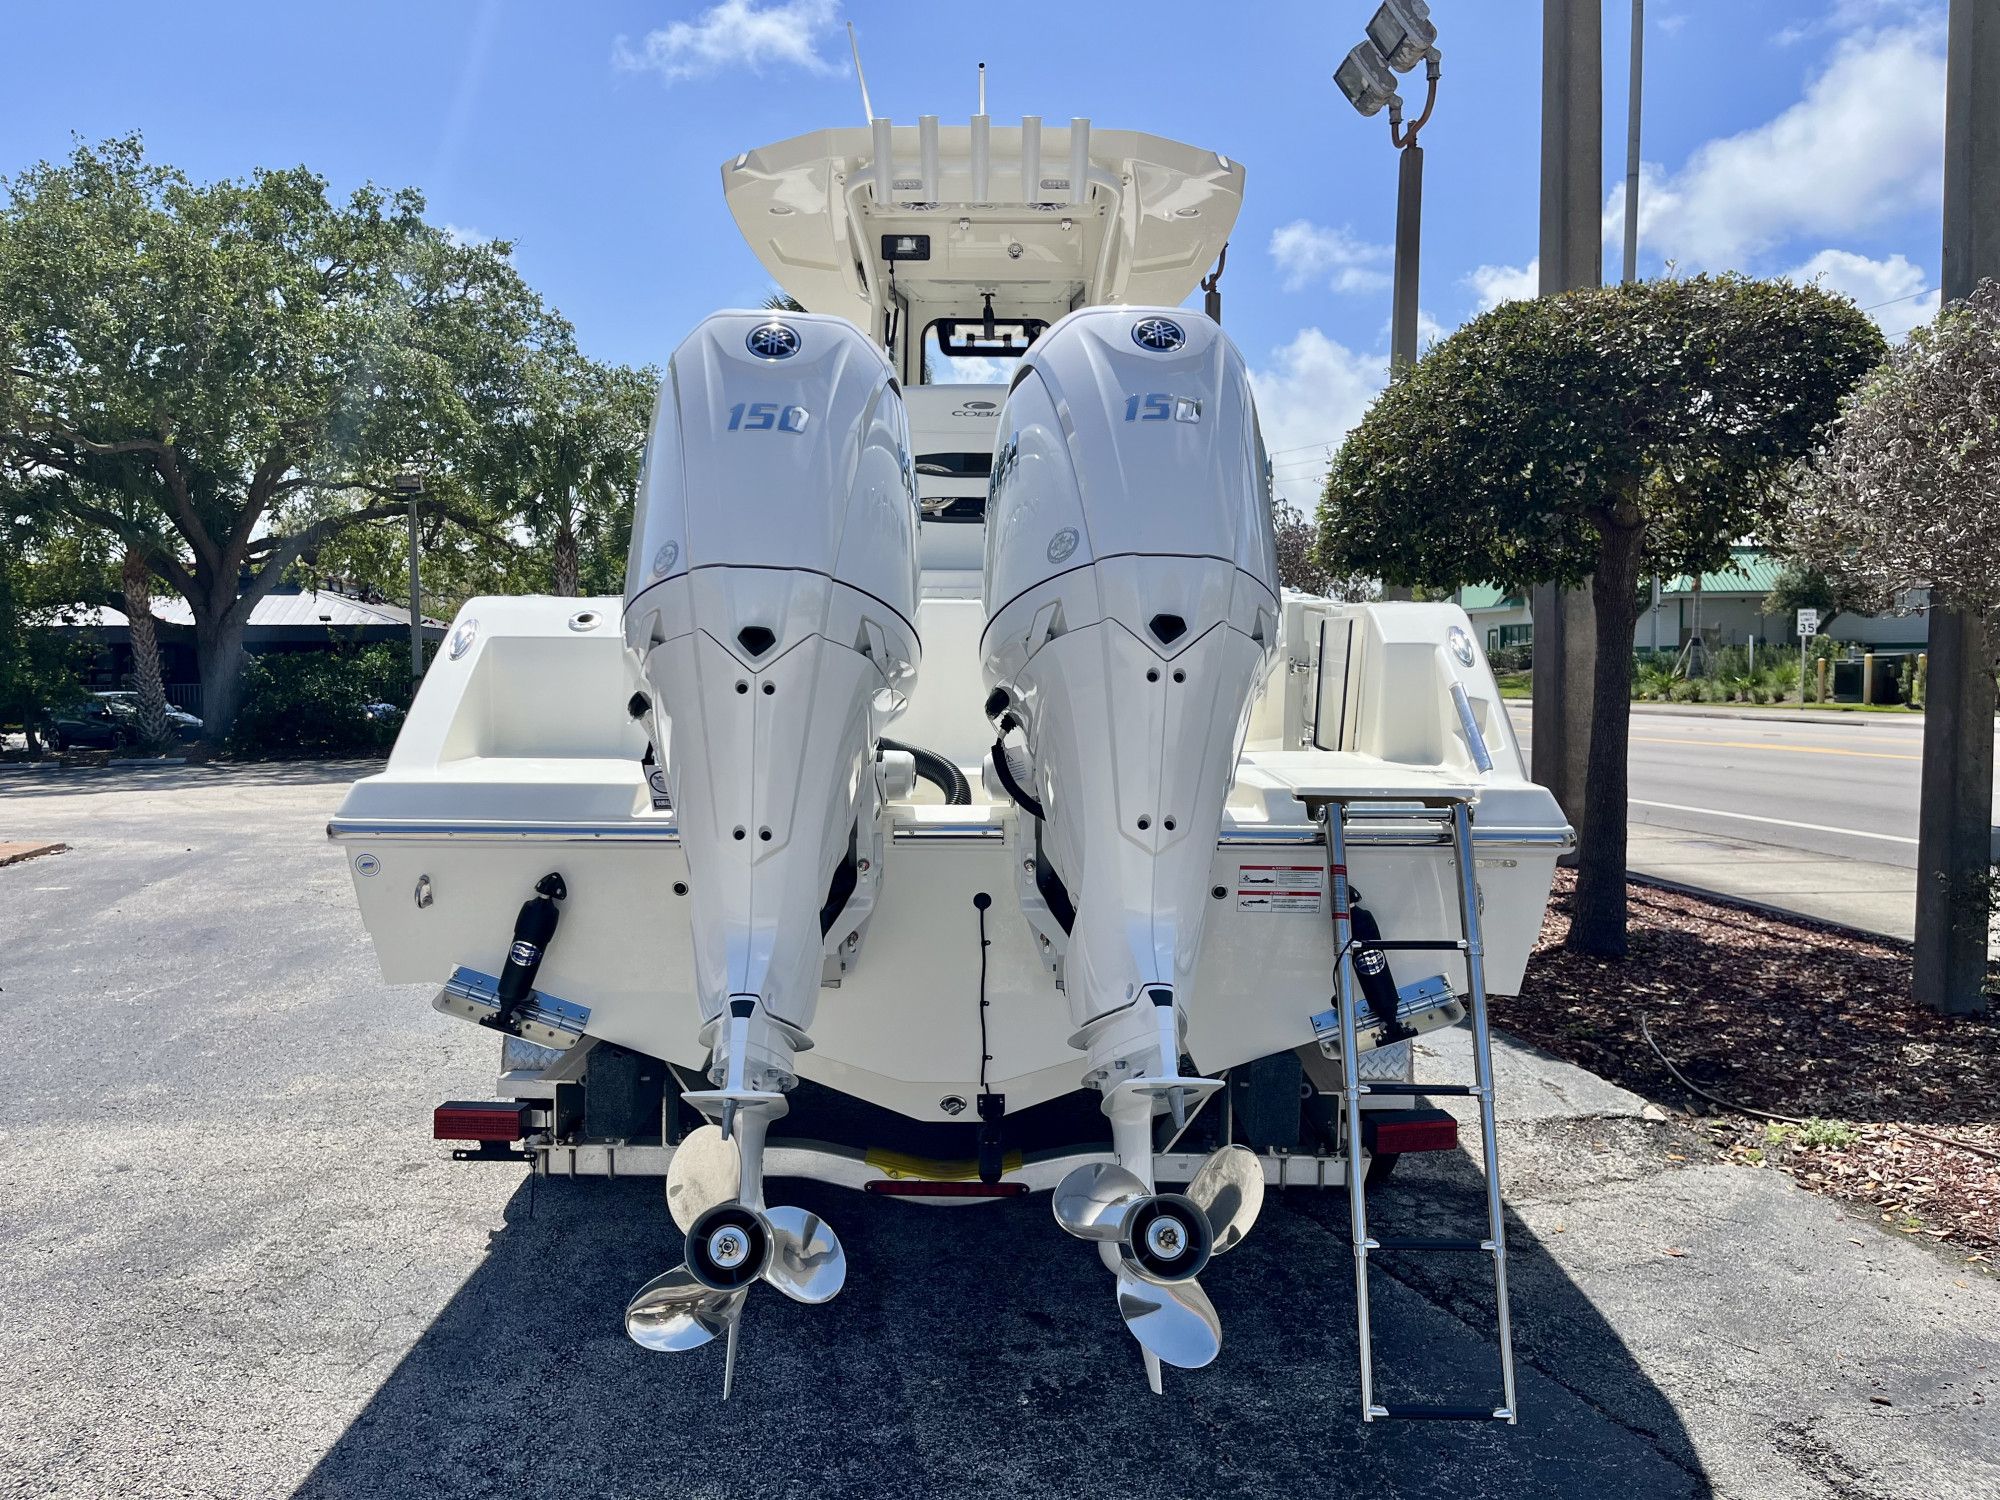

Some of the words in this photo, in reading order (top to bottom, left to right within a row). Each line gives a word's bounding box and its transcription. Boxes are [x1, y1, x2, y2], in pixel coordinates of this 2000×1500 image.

[727, 403, 809, 434] 150
[1125, 393, 1203, 424] 150
[1800, 623, 1815, 633] 35
